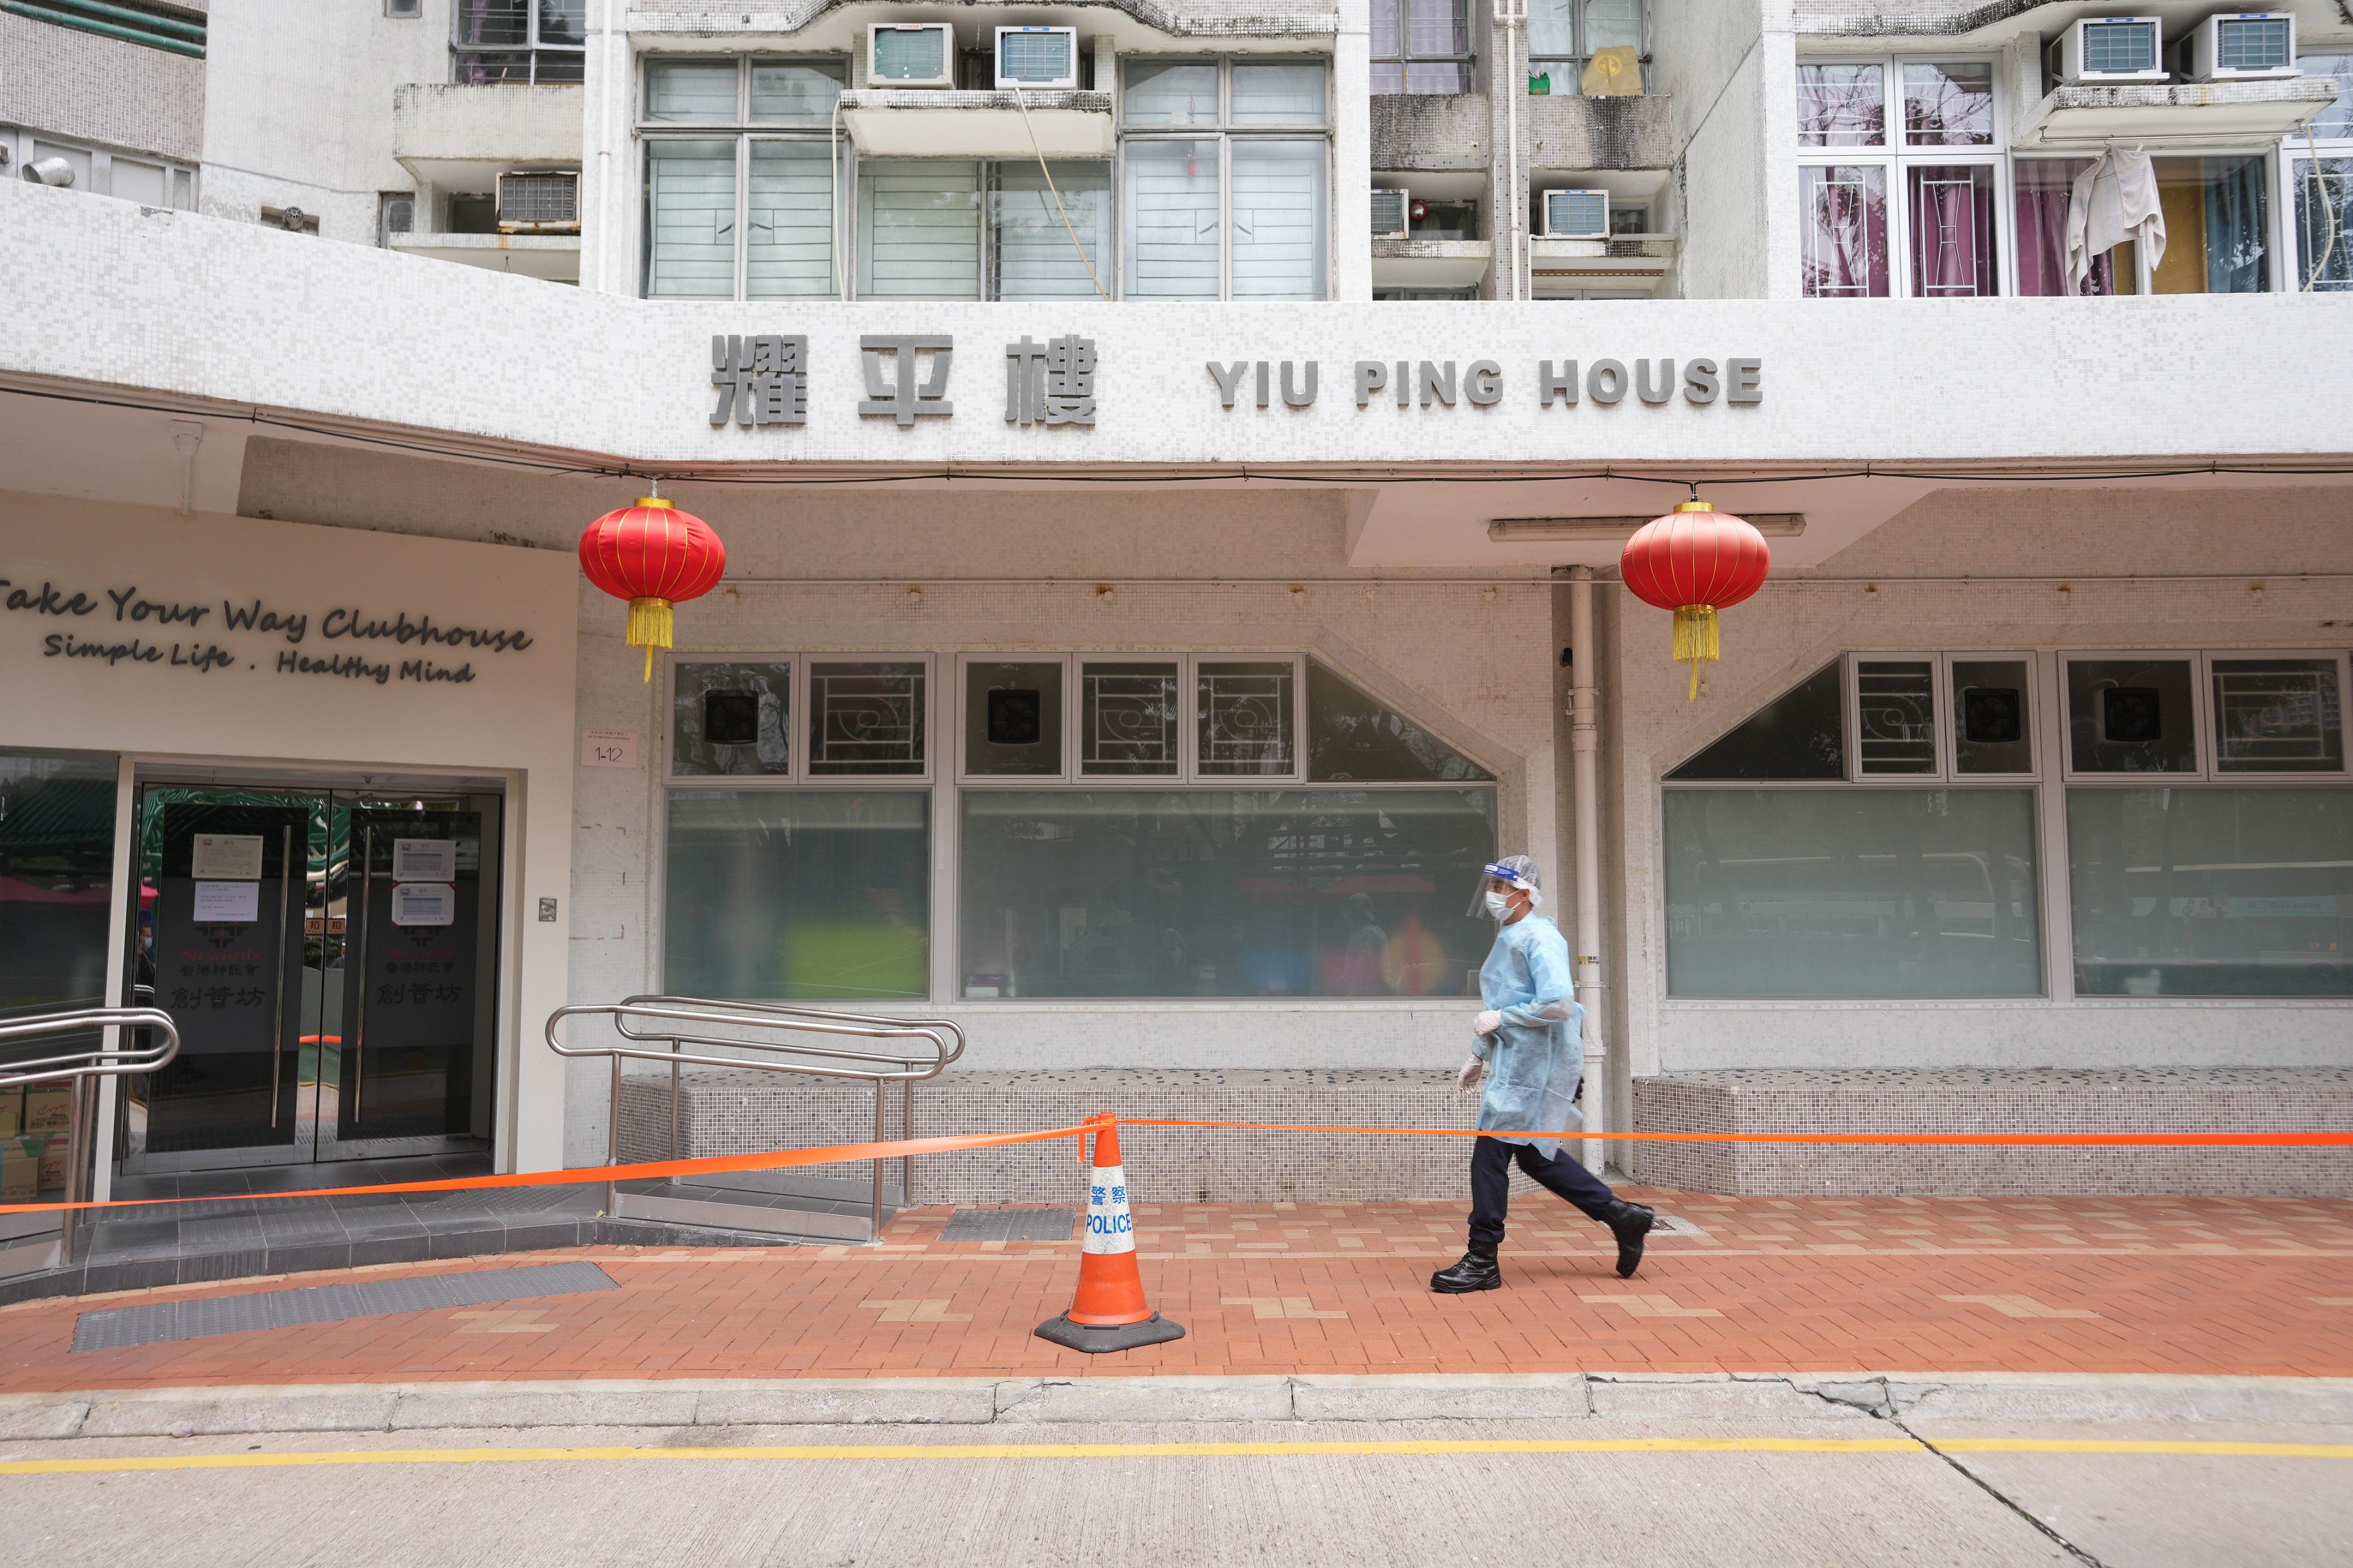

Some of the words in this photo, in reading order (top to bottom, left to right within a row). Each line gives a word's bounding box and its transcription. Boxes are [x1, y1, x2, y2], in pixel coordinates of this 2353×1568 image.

[710, 334, 1097, 427] 耀平樓
[1208, 360, 1319, 407] YIU
[1355, 359, 1504, 407] PING
[1539, 358, 1763, 406] HOUSE
[0, 580, 98, 616] ake
[107, 586, 211, 627] Your
[223, 600, 308, 644] Way
[322, 608, 534, 653] Clubhouse
[44, 634, 163, 665] Simple
[171, 643, 235, 673] Life
[277, 650, 390, 685] Healthy
[400, 660, 476, 684] Mind
[595, 746, 623, 762] 1-12
[1091, 1185, 1126, 1205] 警察
[1086, 1212, 1132, 1234] POLICE
